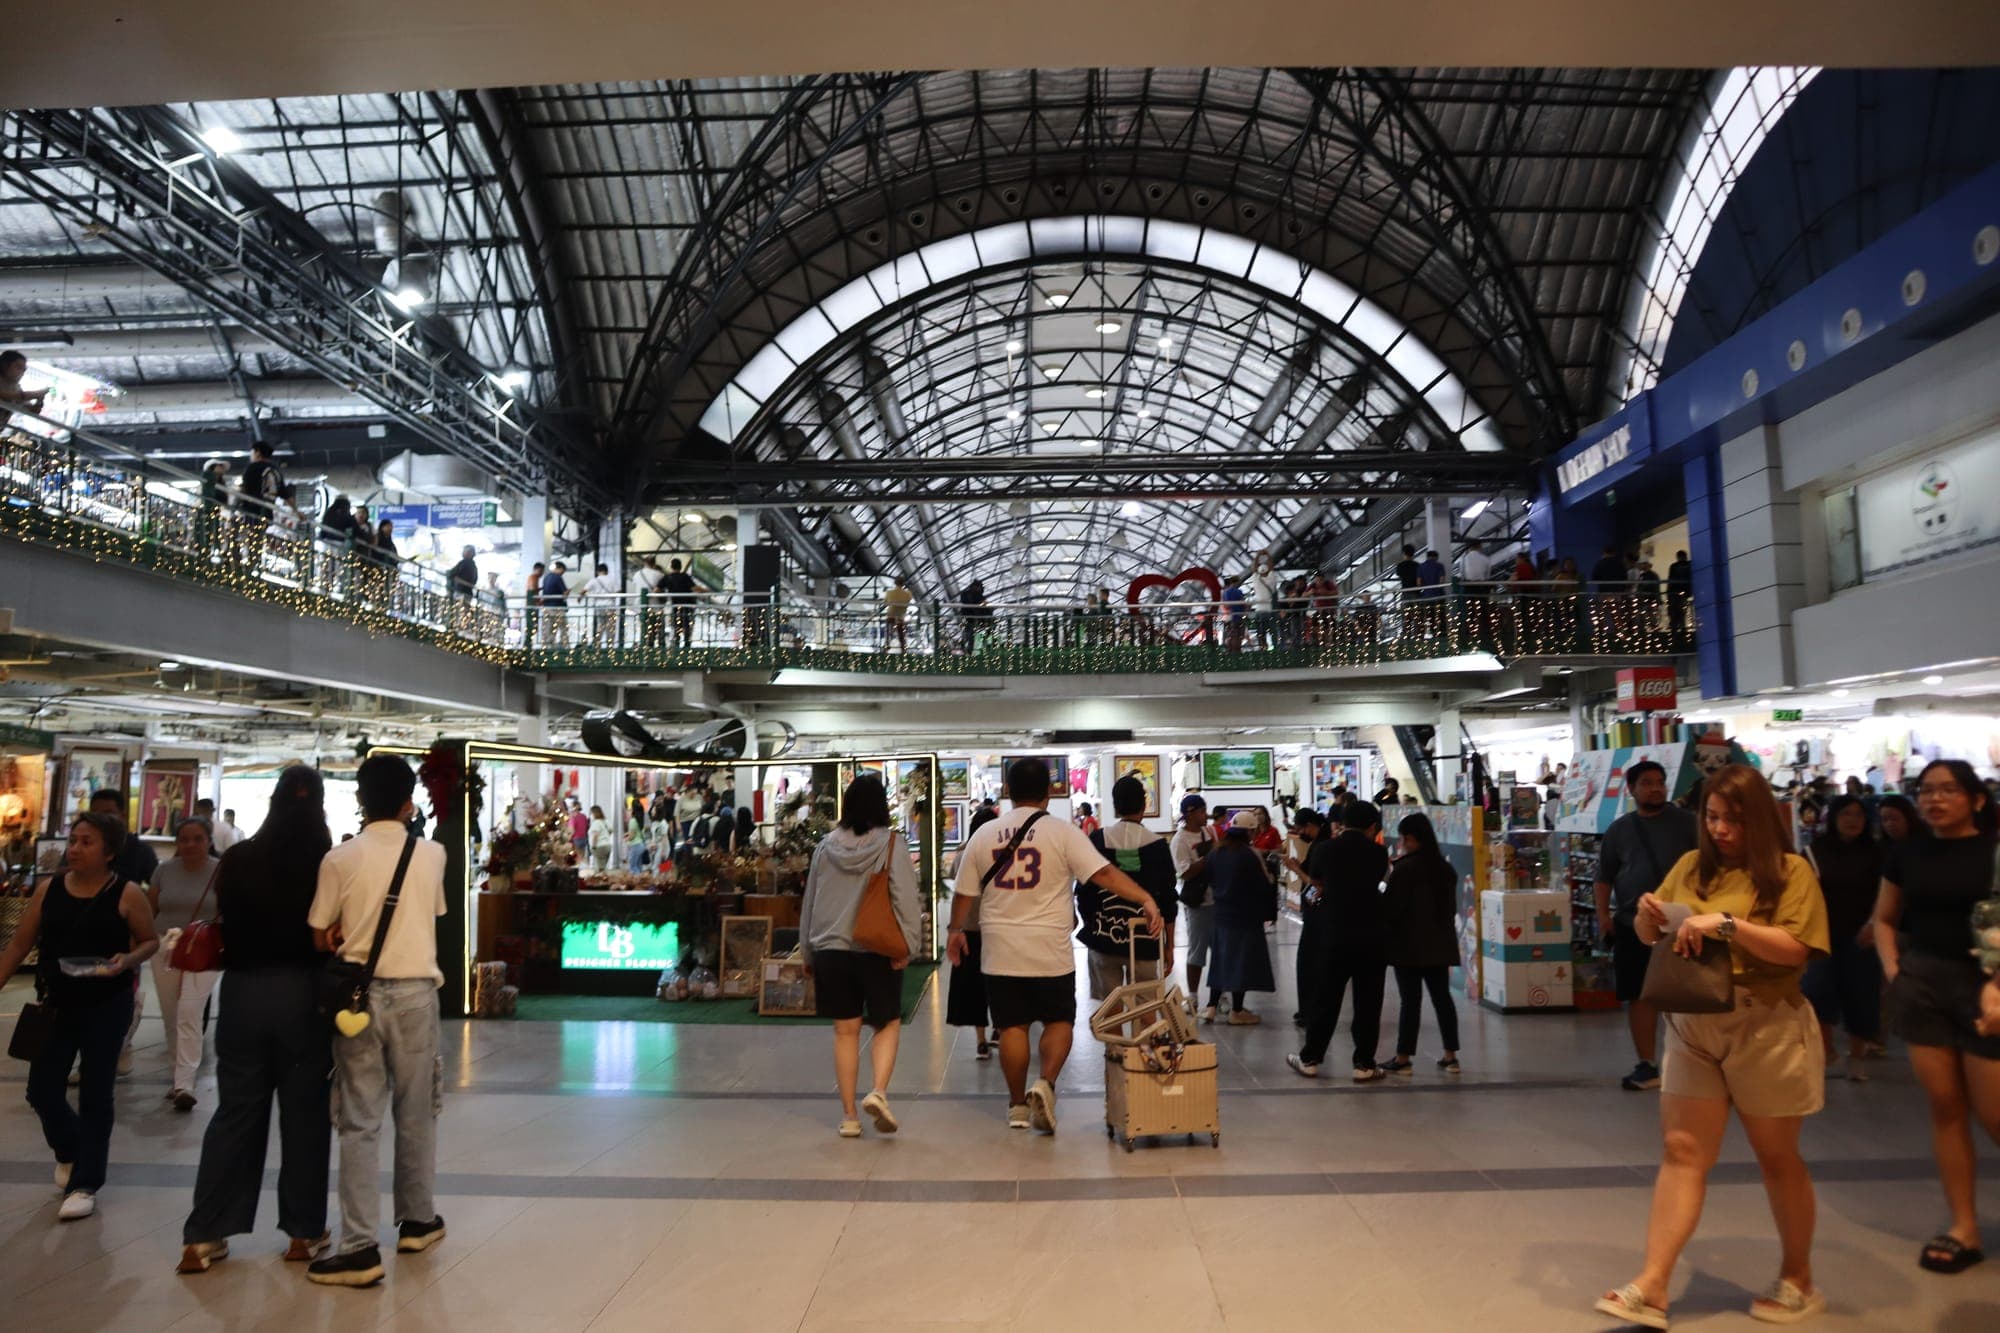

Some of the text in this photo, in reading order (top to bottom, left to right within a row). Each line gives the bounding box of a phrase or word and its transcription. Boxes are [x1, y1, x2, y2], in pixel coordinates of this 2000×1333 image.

[432, 504, 481, 512] CONNECTICUT
[1639, 680, 1673, 697] LEGO
[1774, 711, 1797, 720] EXIT
[992, 847, 1042, 890] 23
[565, 957, 621, 968] DESIGNER
